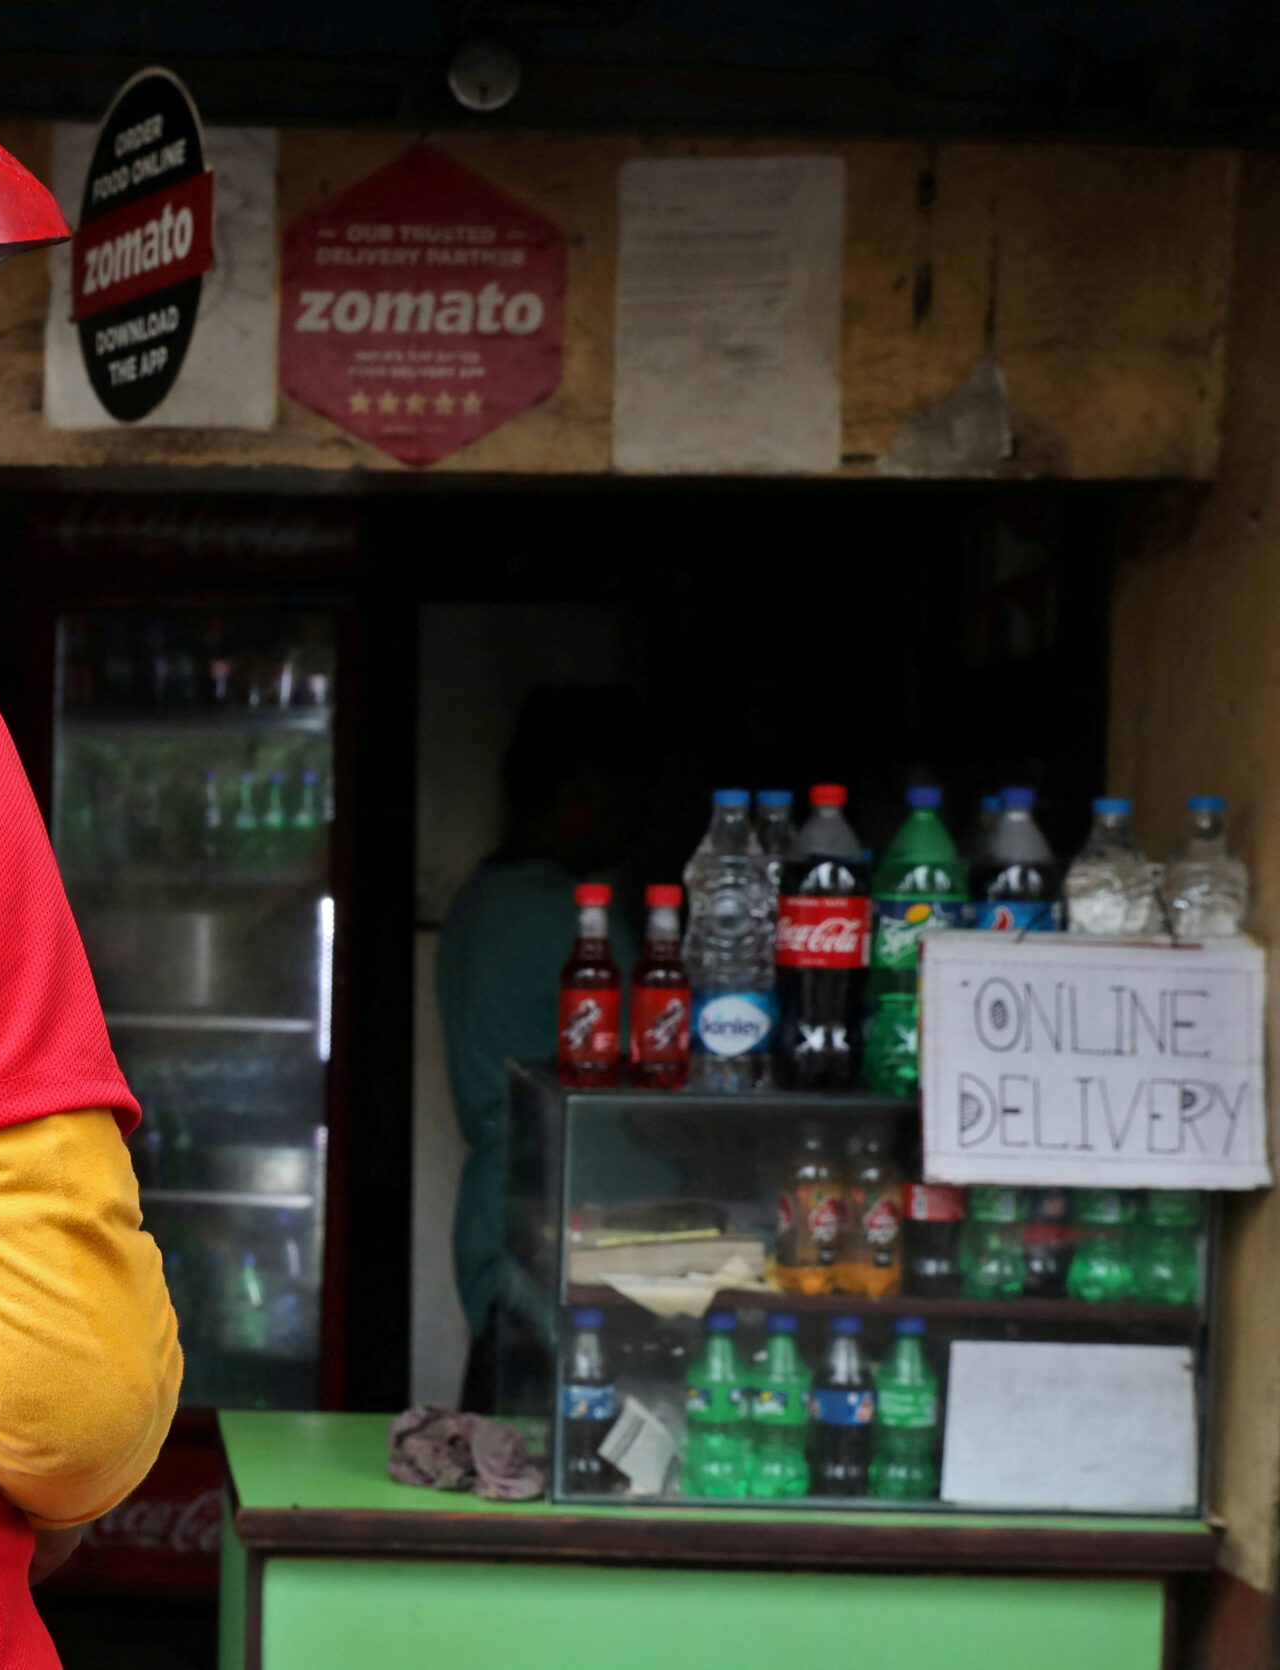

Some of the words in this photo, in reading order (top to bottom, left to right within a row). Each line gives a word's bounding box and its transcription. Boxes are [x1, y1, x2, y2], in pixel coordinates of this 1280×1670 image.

[114, 114, 164, 156] ORDER
[93, 164, 129, 200] FOOD
[131, 138, 187, 181] ONLINE
[82, 203, 194, 295] zomato
[315, 247, 421, 266] DELIVERY
[346, 224, 395, 243] OUR
[400, 225, 497, 244] TRUSTED
[95, 305, 180, 355] DOWNLOAD
[294, 281, 544, 335] zomato
[108, 356, 139, 386] THE
[139, 346, 169, 378] APP
[973, 975, 1213, 1059] ONLINE
[957, 1071, 1252, 1157] DELIVERY
